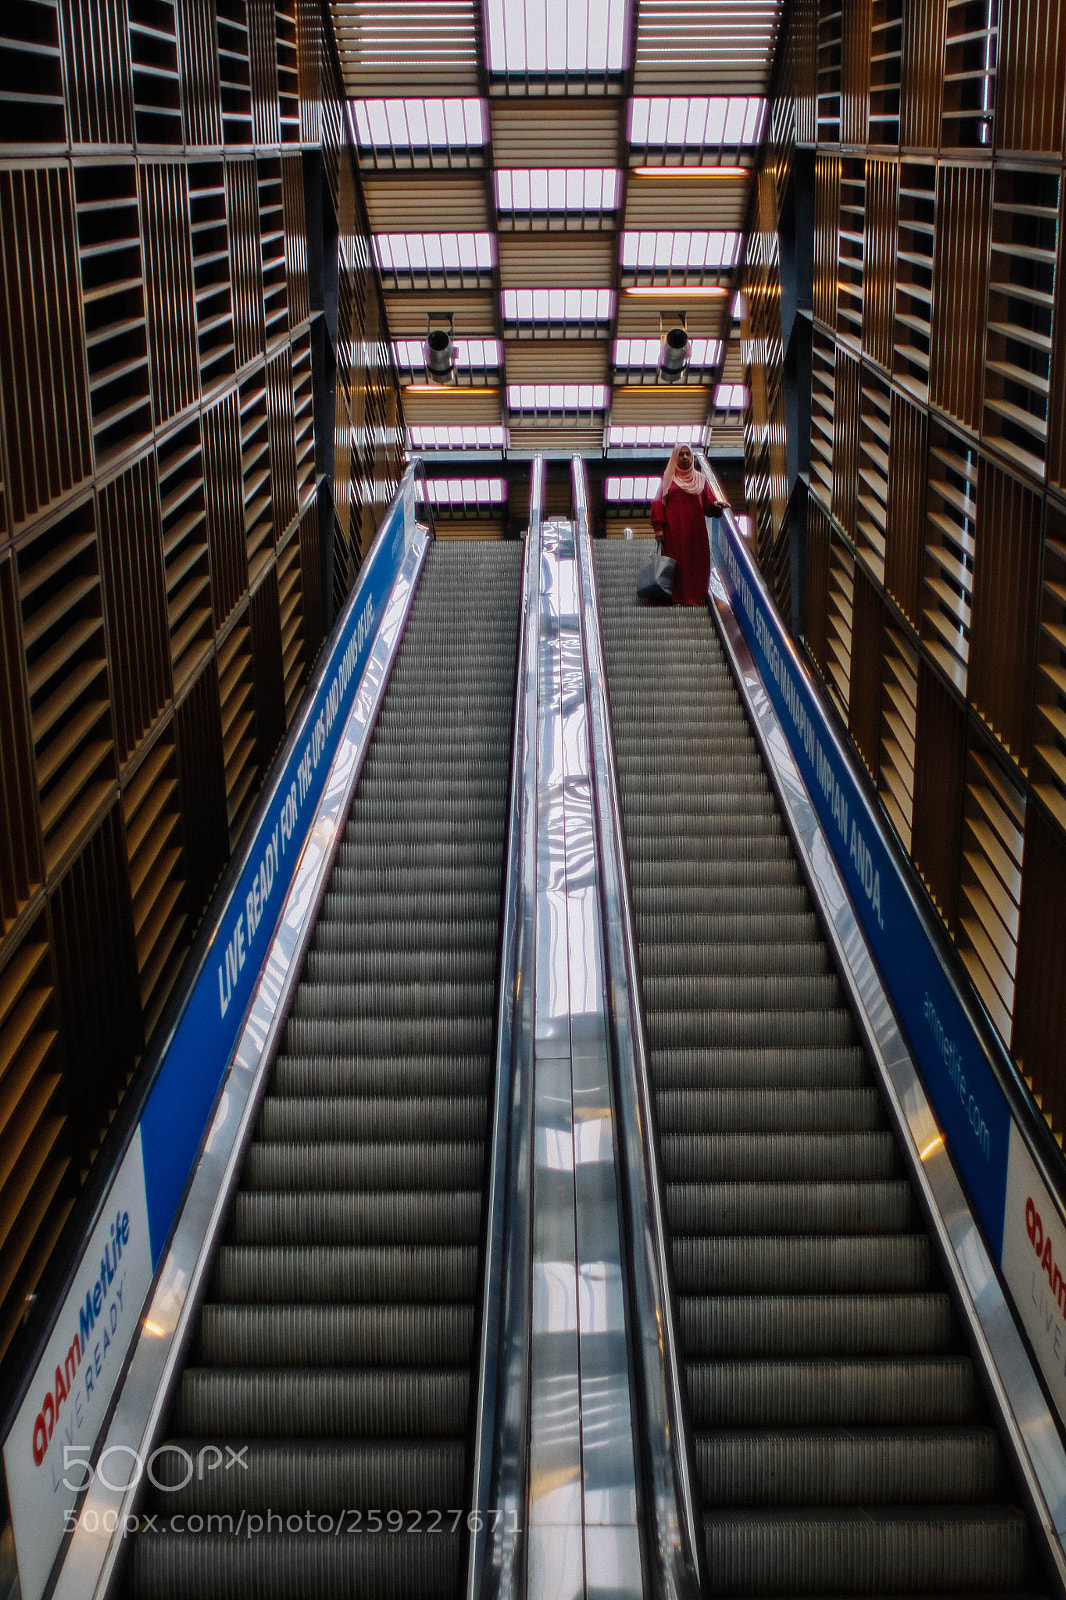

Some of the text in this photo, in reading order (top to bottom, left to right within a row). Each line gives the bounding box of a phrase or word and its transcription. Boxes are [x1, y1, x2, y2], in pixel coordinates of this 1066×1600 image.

[218, 912, 246, 1019] LIVE
[246, 822, 279, 947] READY
[280, 781, 298, 855] FOR
[297, 741, 313, 807] THE
[312, 708, 325, 769] UPS
[325, 677, 339, 738] AND
[338, 629, 358, 702] DOWNS
[357, 612, 364, 653] OF
[816, 739, 848, 845] IMPIAN
[51, 1280, 125, 1494] LIVE READY
[1031, 1270, 1062, 1360] LIVE
